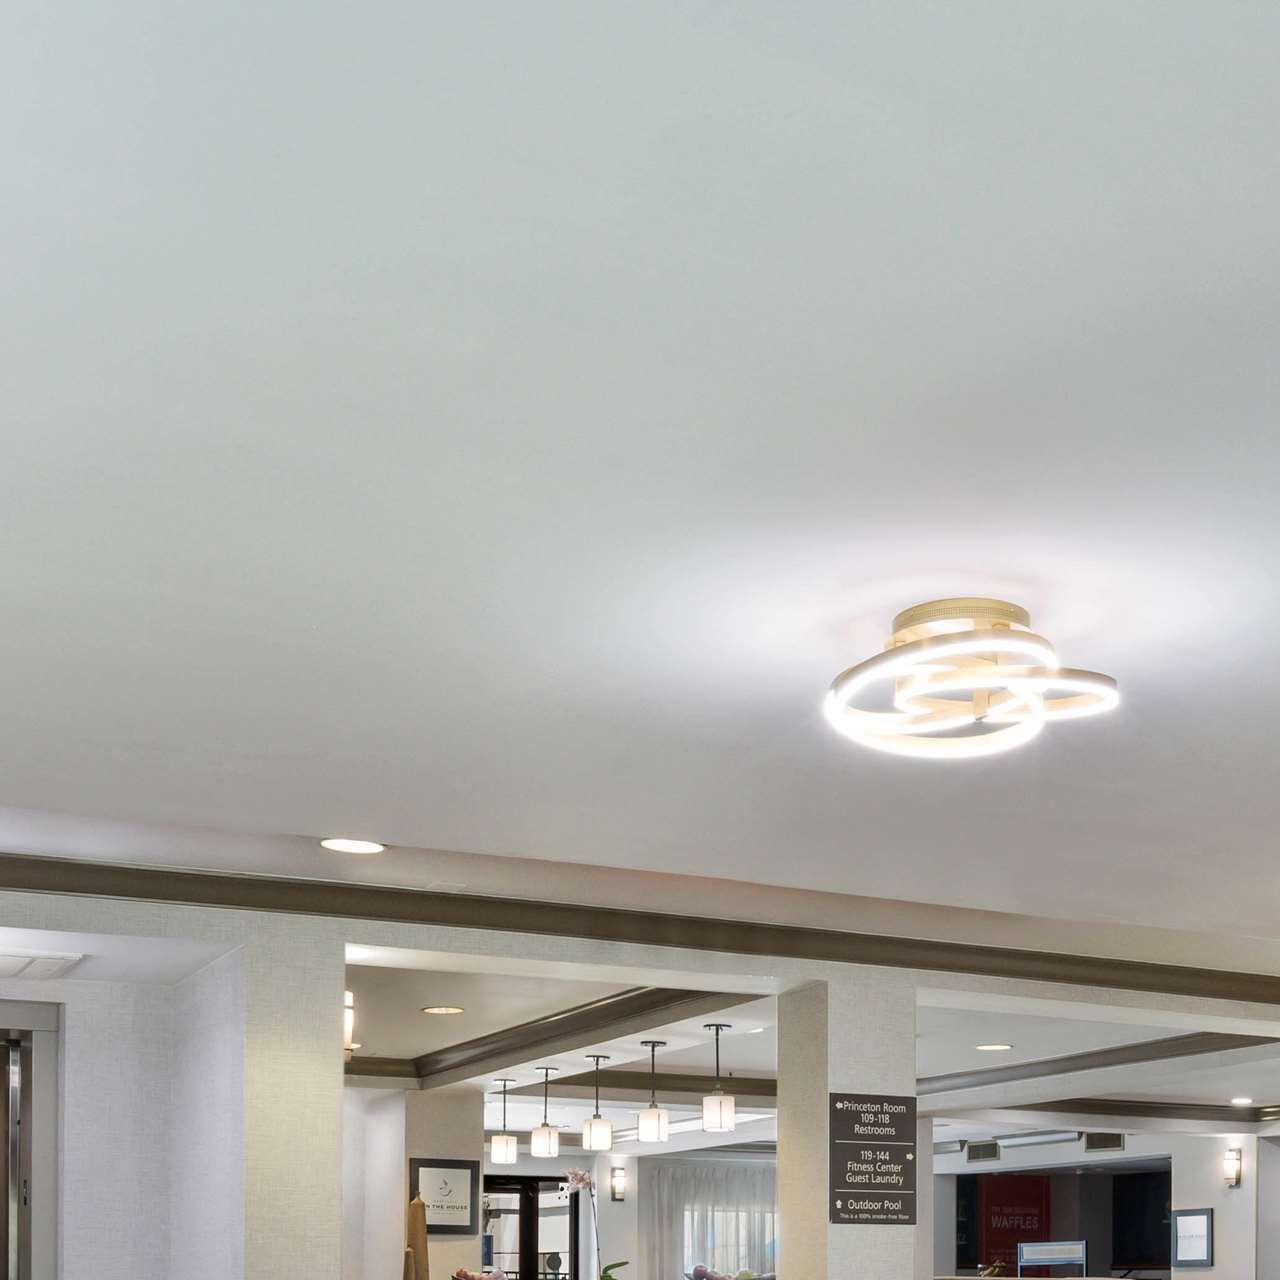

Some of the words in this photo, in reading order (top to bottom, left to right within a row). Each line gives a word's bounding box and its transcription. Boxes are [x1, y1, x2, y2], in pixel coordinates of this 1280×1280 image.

[843, 1101, 881, 1112] Princeton
[883, 1102, 906, 1113] Room
[860, 1113, 890, 1124] 109-118
[854, 1124, 896, 1135] Restrooms
[860, 1150, 890, 1160] 119-144
[847, 1161, 874, 1172] Fitness
[875, 1162, 903, 1173] Center
[845, 1172, 869, 1183] Guest
[871, 1173, 904, 1186] Laundry
[847, 1199, 882, 1210] Outdoor
[883, 1200, 902, 1210] Pool
[991, 1215, 1040, 1230] WAFFLES
